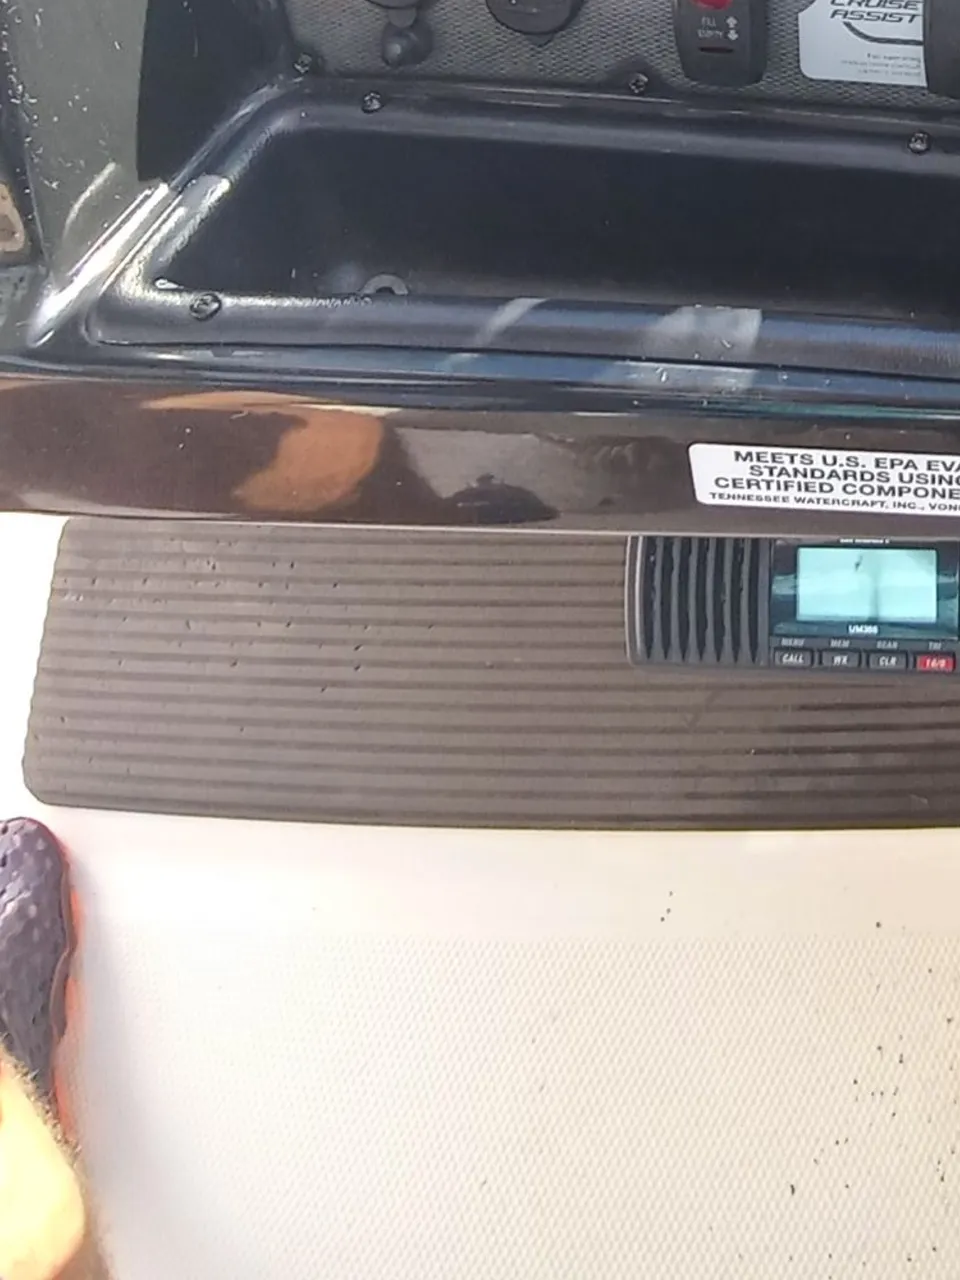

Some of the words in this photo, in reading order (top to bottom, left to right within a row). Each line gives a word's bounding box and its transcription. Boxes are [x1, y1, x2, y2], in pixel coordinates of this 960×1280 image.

[829, 9, 924, 25] ASSIST
[733, 450, 815, 466] MEETS
[822, 454, 866, 468] U.S.
[874, 456, 919, 471] EPA
[749, 464, 891, 483] STANDARDS
[713, 476, 835, 494] CERTIFIED
[709, 491, 790, 504] TENNESSEE
[782, 655, 804, 664] CALL
